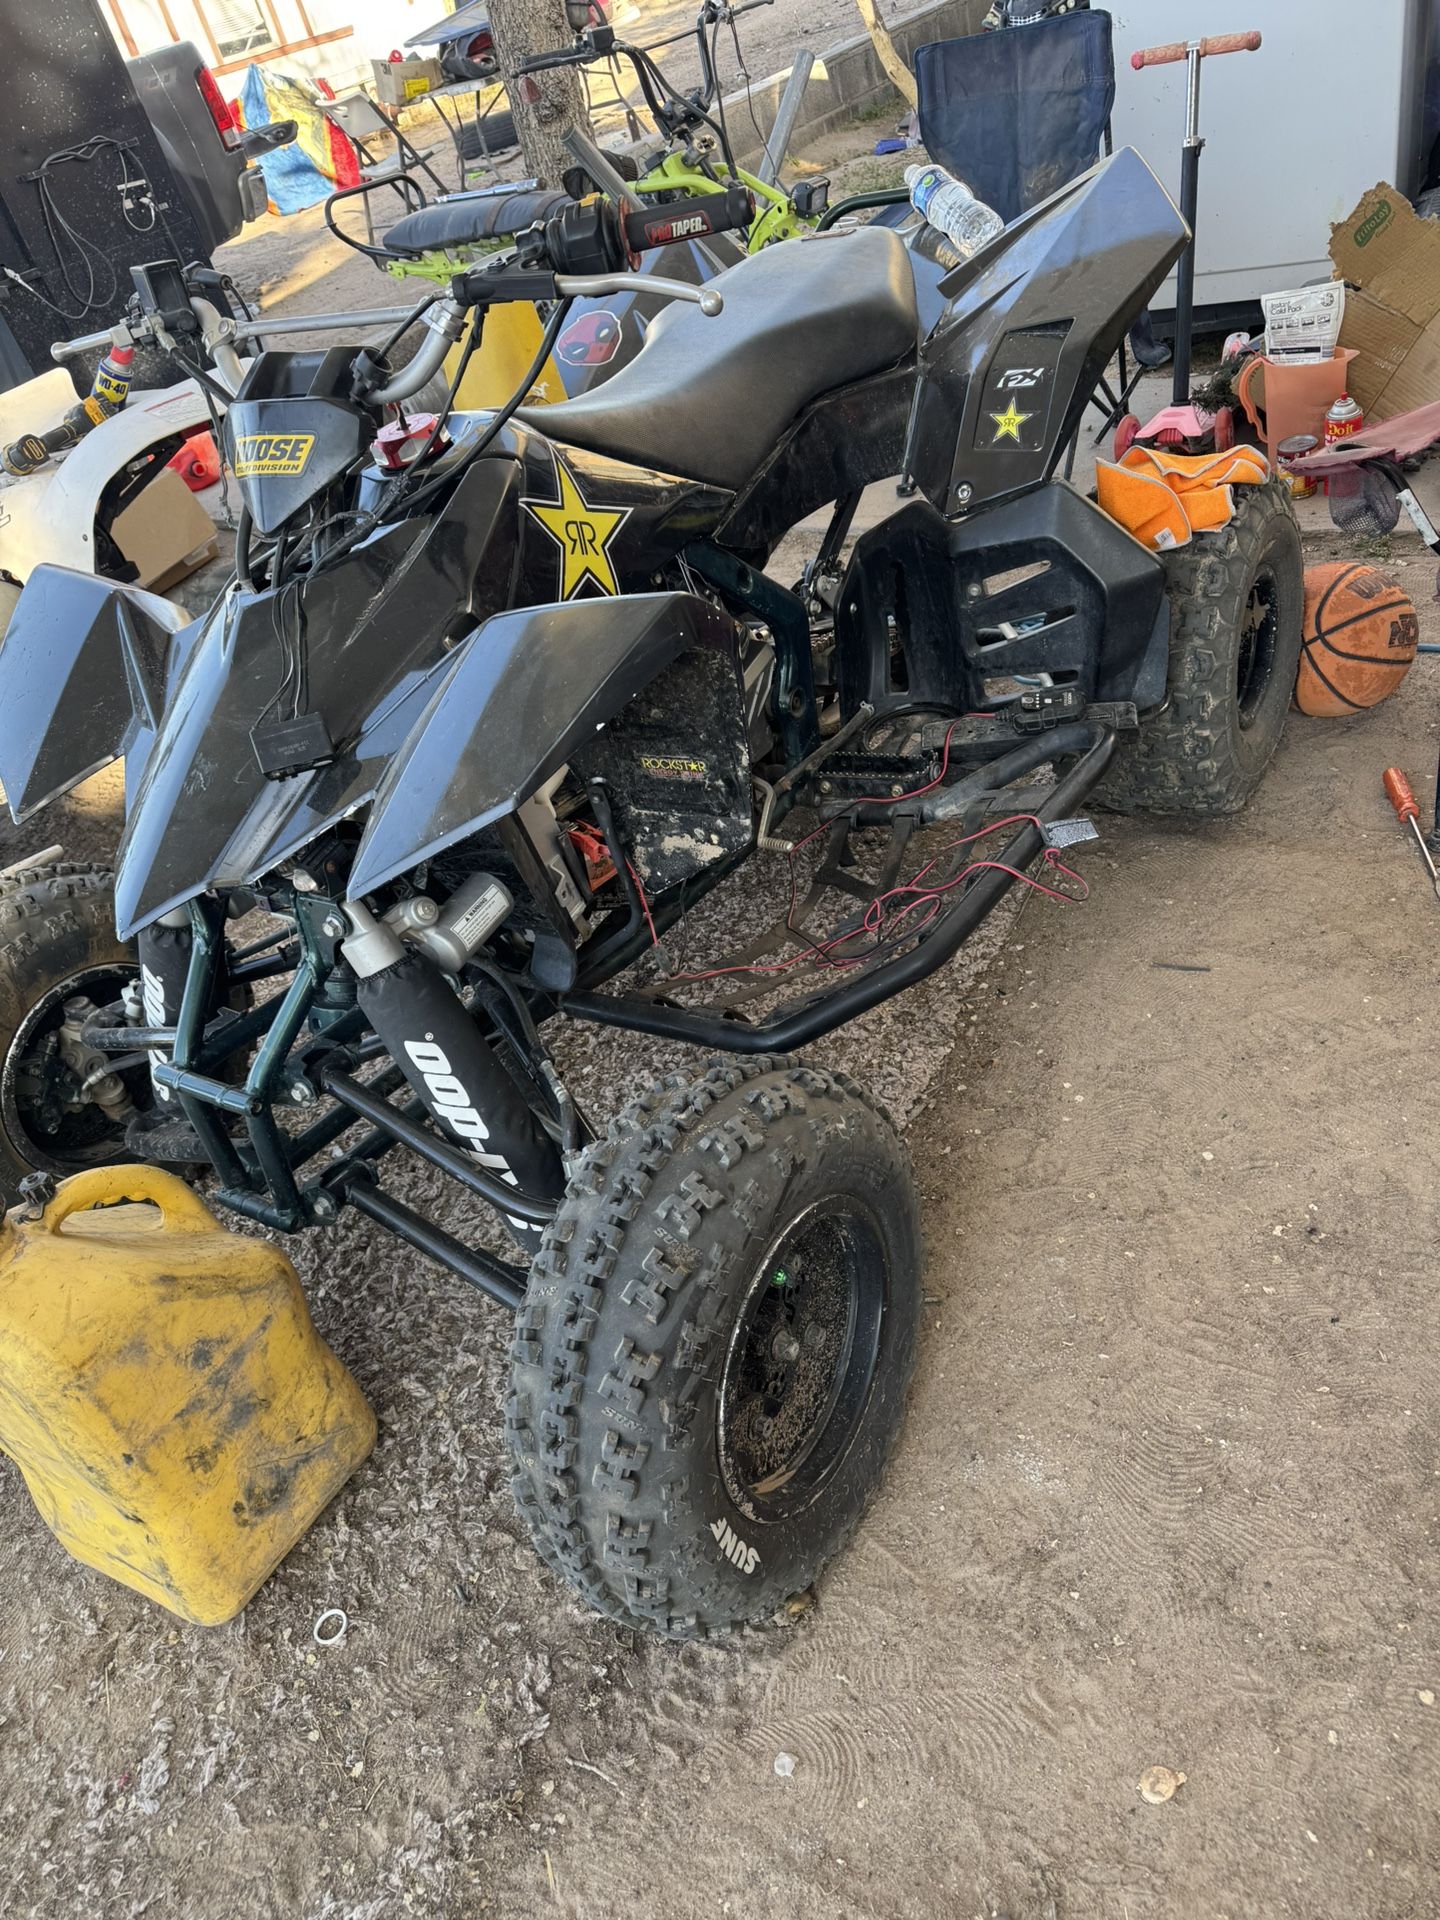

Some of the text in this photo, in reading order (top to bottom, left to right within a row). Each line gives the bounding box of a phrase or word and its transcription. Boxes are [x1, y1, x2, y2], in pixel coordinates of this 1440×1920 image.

[1270, 300, 1291, 309] Instant
[1270, 305, 1302, 315] Cold Pack
[98, 373, 127, 395] WD-40
[1328, 423, 1354, 436] Do it
[252, 463, 300, 472] DIVISION
[404, 1040, 545, 1233] i-doo
[709, 1516, 762, 1575] SUNF
